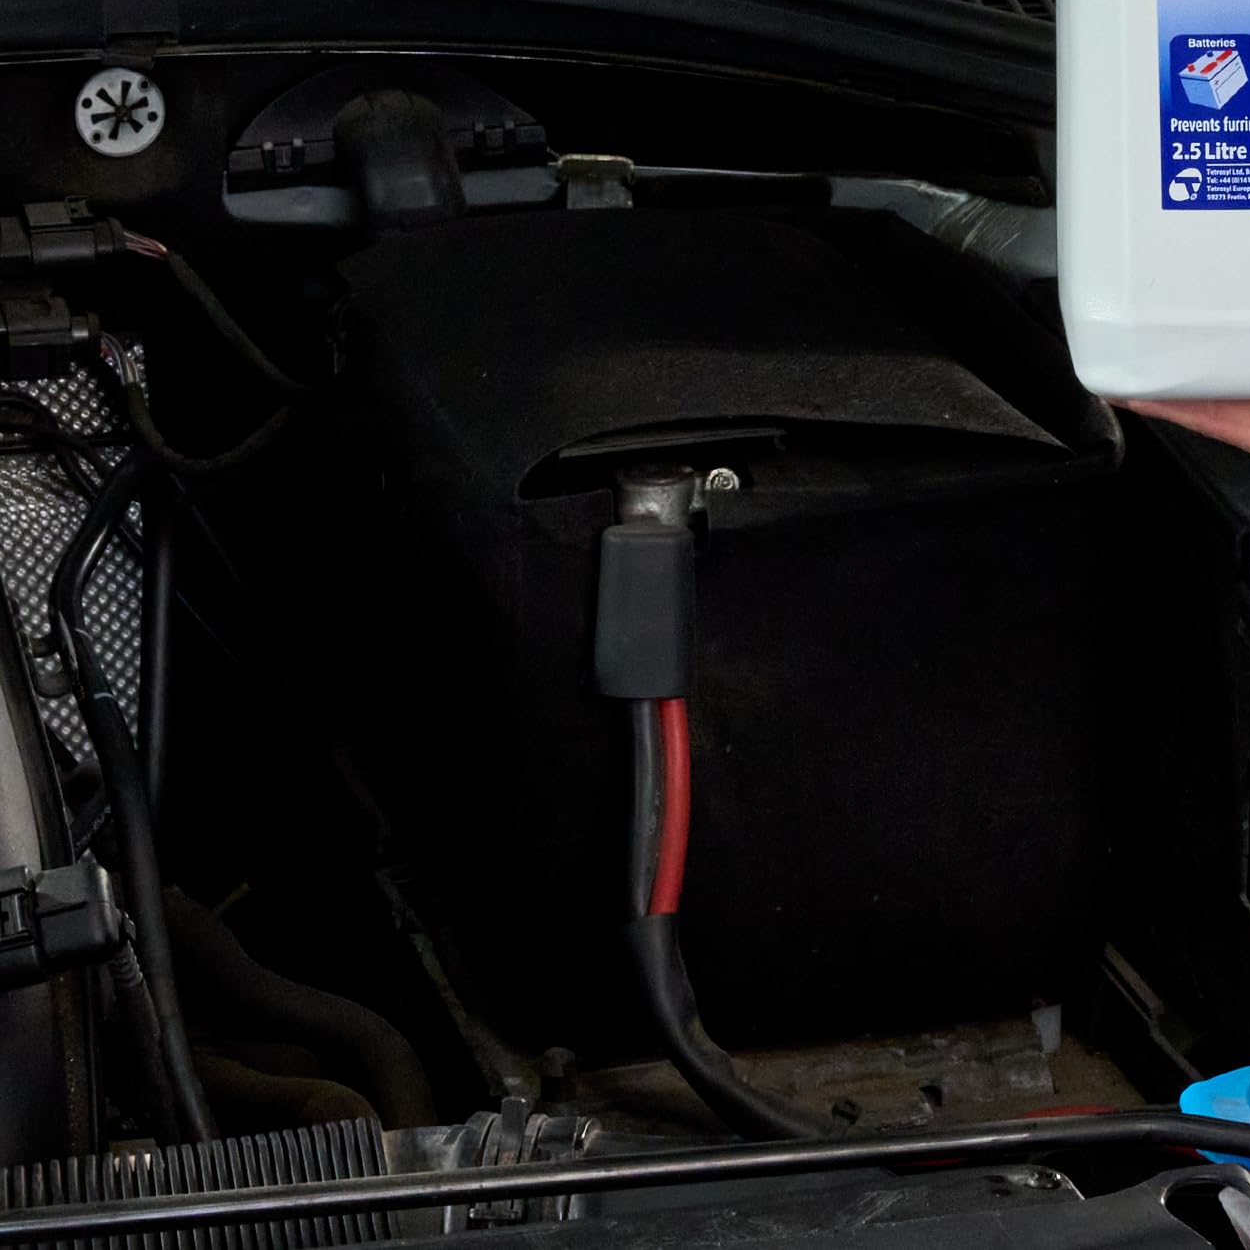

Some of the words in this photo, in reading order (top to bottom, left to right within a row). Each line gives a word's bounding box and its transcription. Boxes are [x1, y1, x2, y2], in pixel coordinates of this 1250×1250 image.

[1188, 38, 1236, 48] Batteries
[1171, 117, 1220, 132] Prevents
[1172, 143, 1201, 159] 2.5
[1205, 142, 1247, 159] Litre
